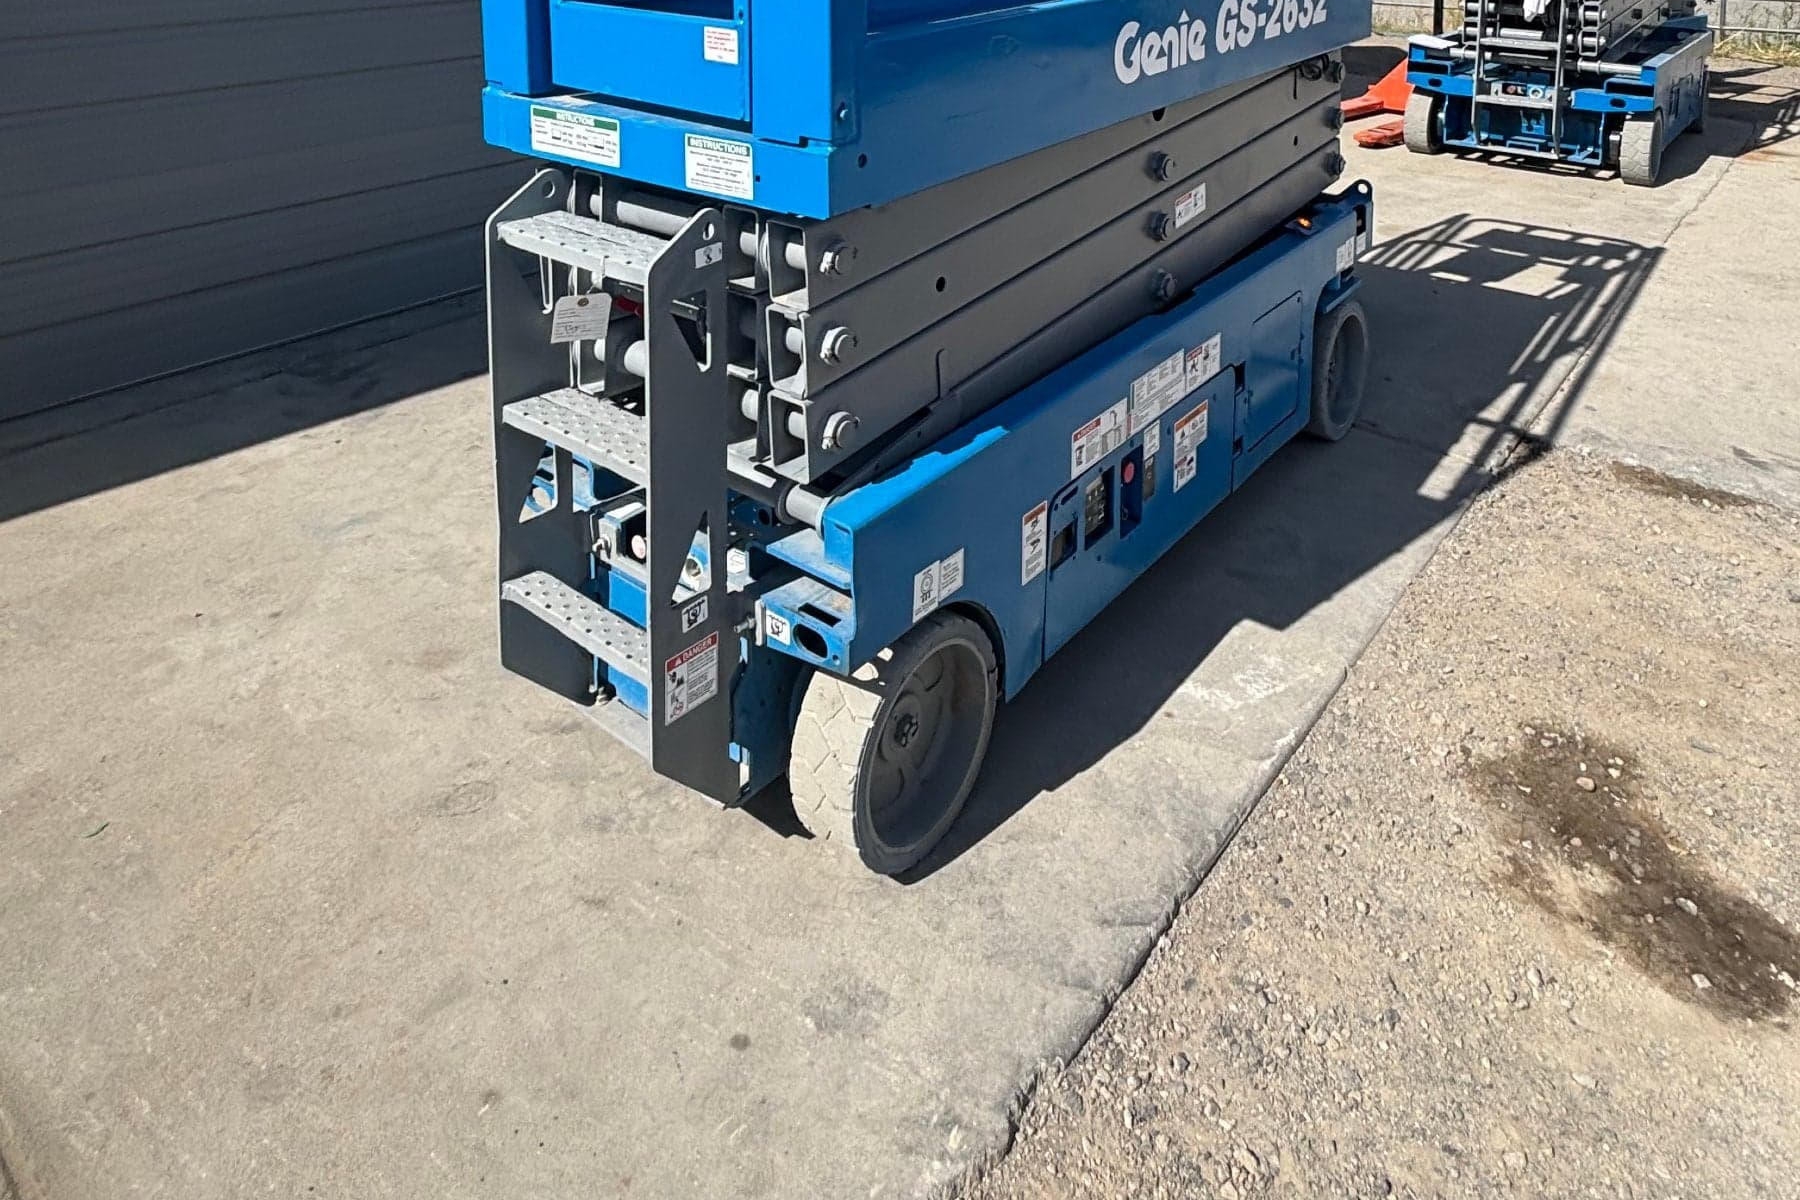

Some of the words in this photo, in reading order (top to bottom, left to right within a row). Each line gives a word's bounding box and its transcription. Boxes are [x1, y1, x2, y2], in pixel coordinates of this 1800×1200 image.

[1114, 8, 1207, 85] Genie
[689, 137, 748, 156] INSTRUCTIONS
[682, 637, 713, 663] DANGER
